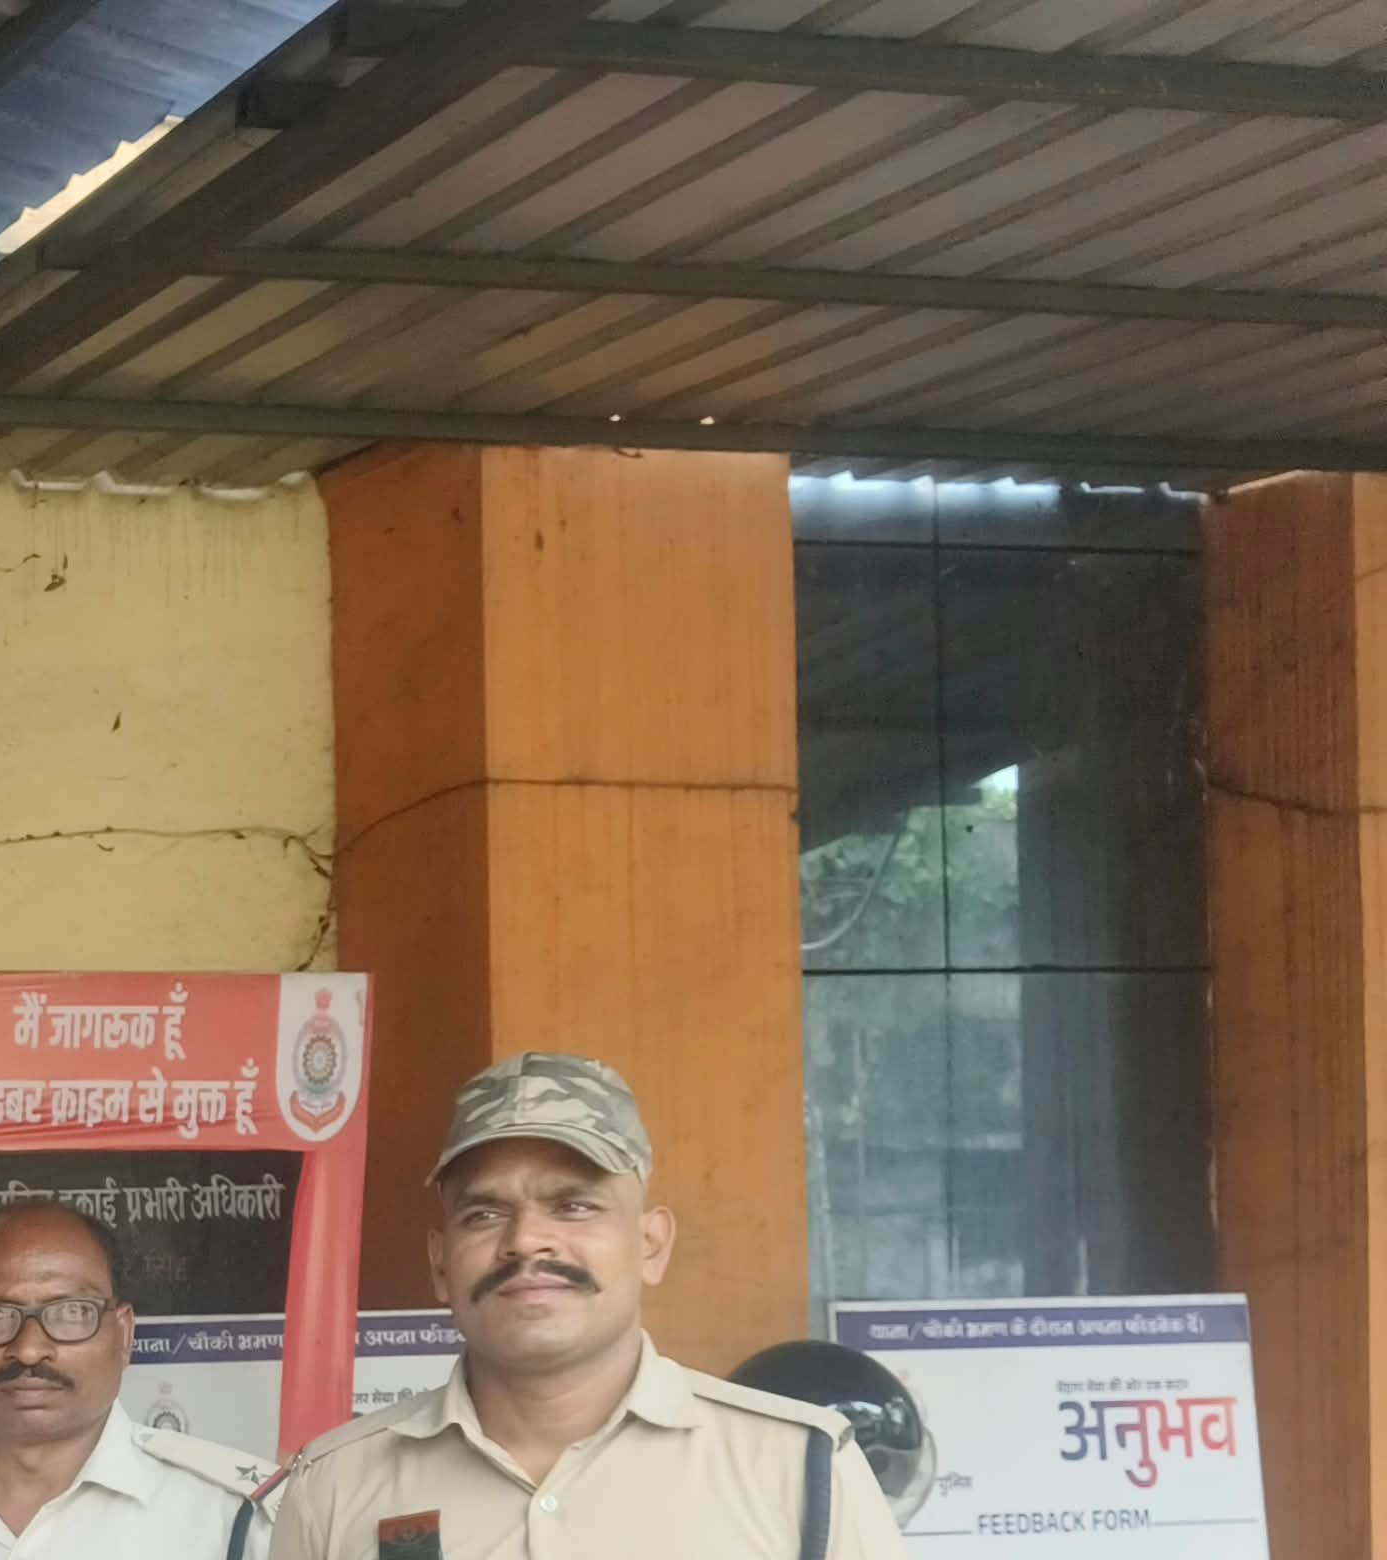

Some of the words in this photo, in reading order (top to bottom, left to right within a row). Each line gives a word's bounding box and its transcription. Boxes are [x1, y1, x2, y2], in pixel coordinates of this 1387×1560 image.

[13, 992, 47, 1050] मैं
[48, 1004, 157, 1050] जागरूक
[162, 981, 188, 1060] हूँ
[49, 1078, 133, 1125] क्राइम
[136, 1068, 167, 1126] से
[171, 1078, 233, 1140] मुक्त
[234, 1057, 260, 1136] हूँ
[125, 1177, 189, 1223] प्रभारी
[190, 1173, 285, 1222] अधिकारी
[364, 1329, 417, 1348] अपना
[1058, 1394, 1239, 1489] अनुभव
[977, 1510, 1087, 1537] FEEDBACK
[1092, 1508, 1152, 1533] FORM
